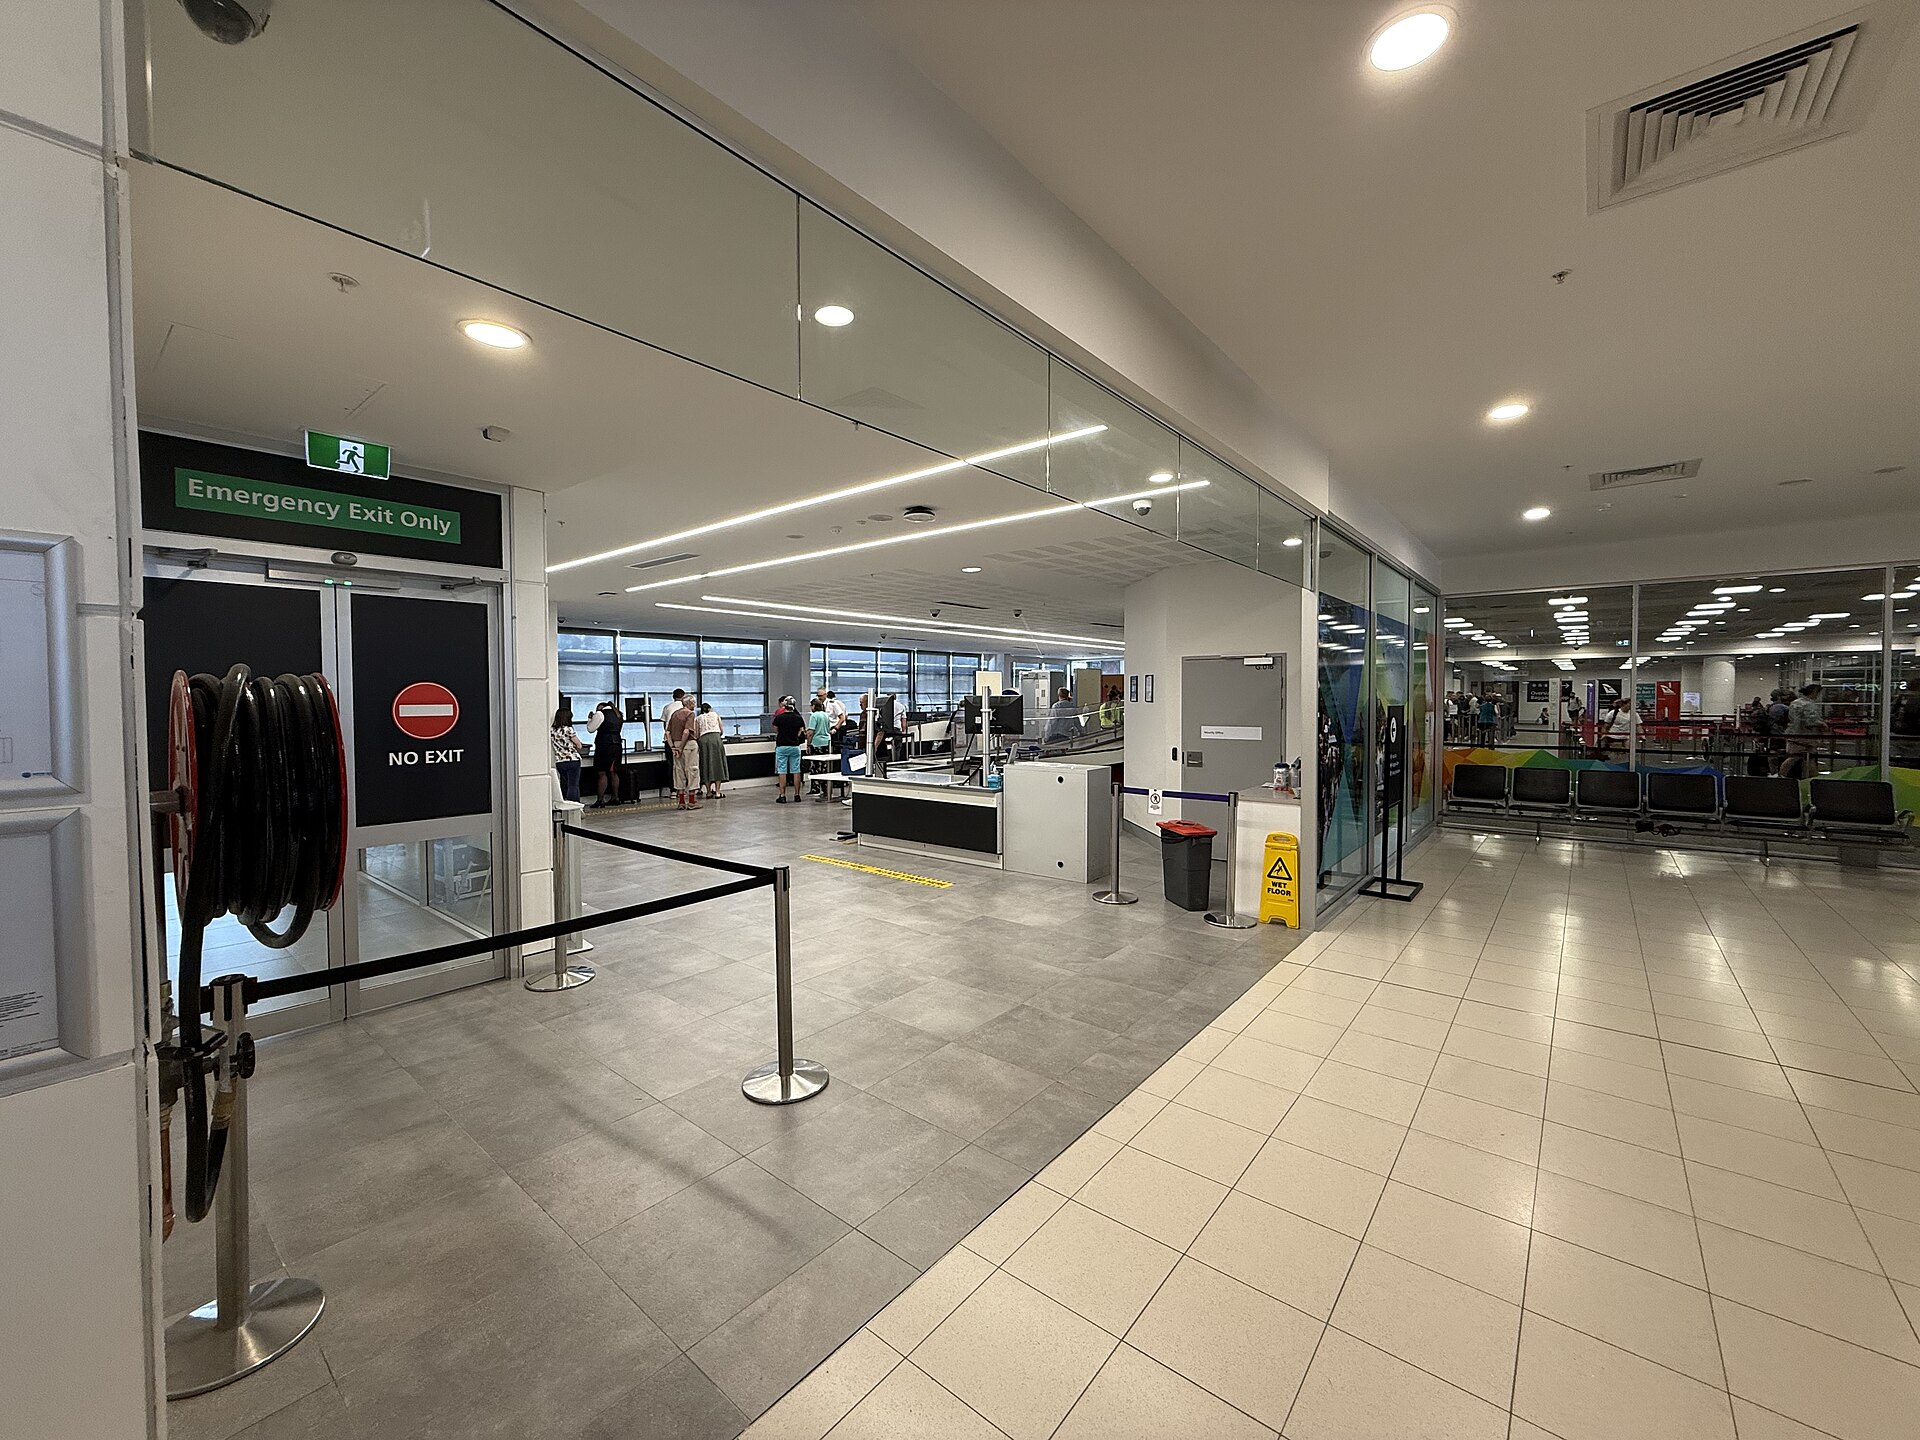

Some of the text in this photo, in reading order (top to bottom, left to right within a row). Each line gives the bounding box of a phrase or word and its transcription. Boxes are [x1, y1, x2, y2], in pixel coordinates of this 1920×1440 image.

[188, 478, 451, 535] Emergency Exit Only
[388, 749, 464, 766] NO EXIT
[1271, 881, 1288, 889] WET
[1267, 887, 1292, 897] FLOOR
